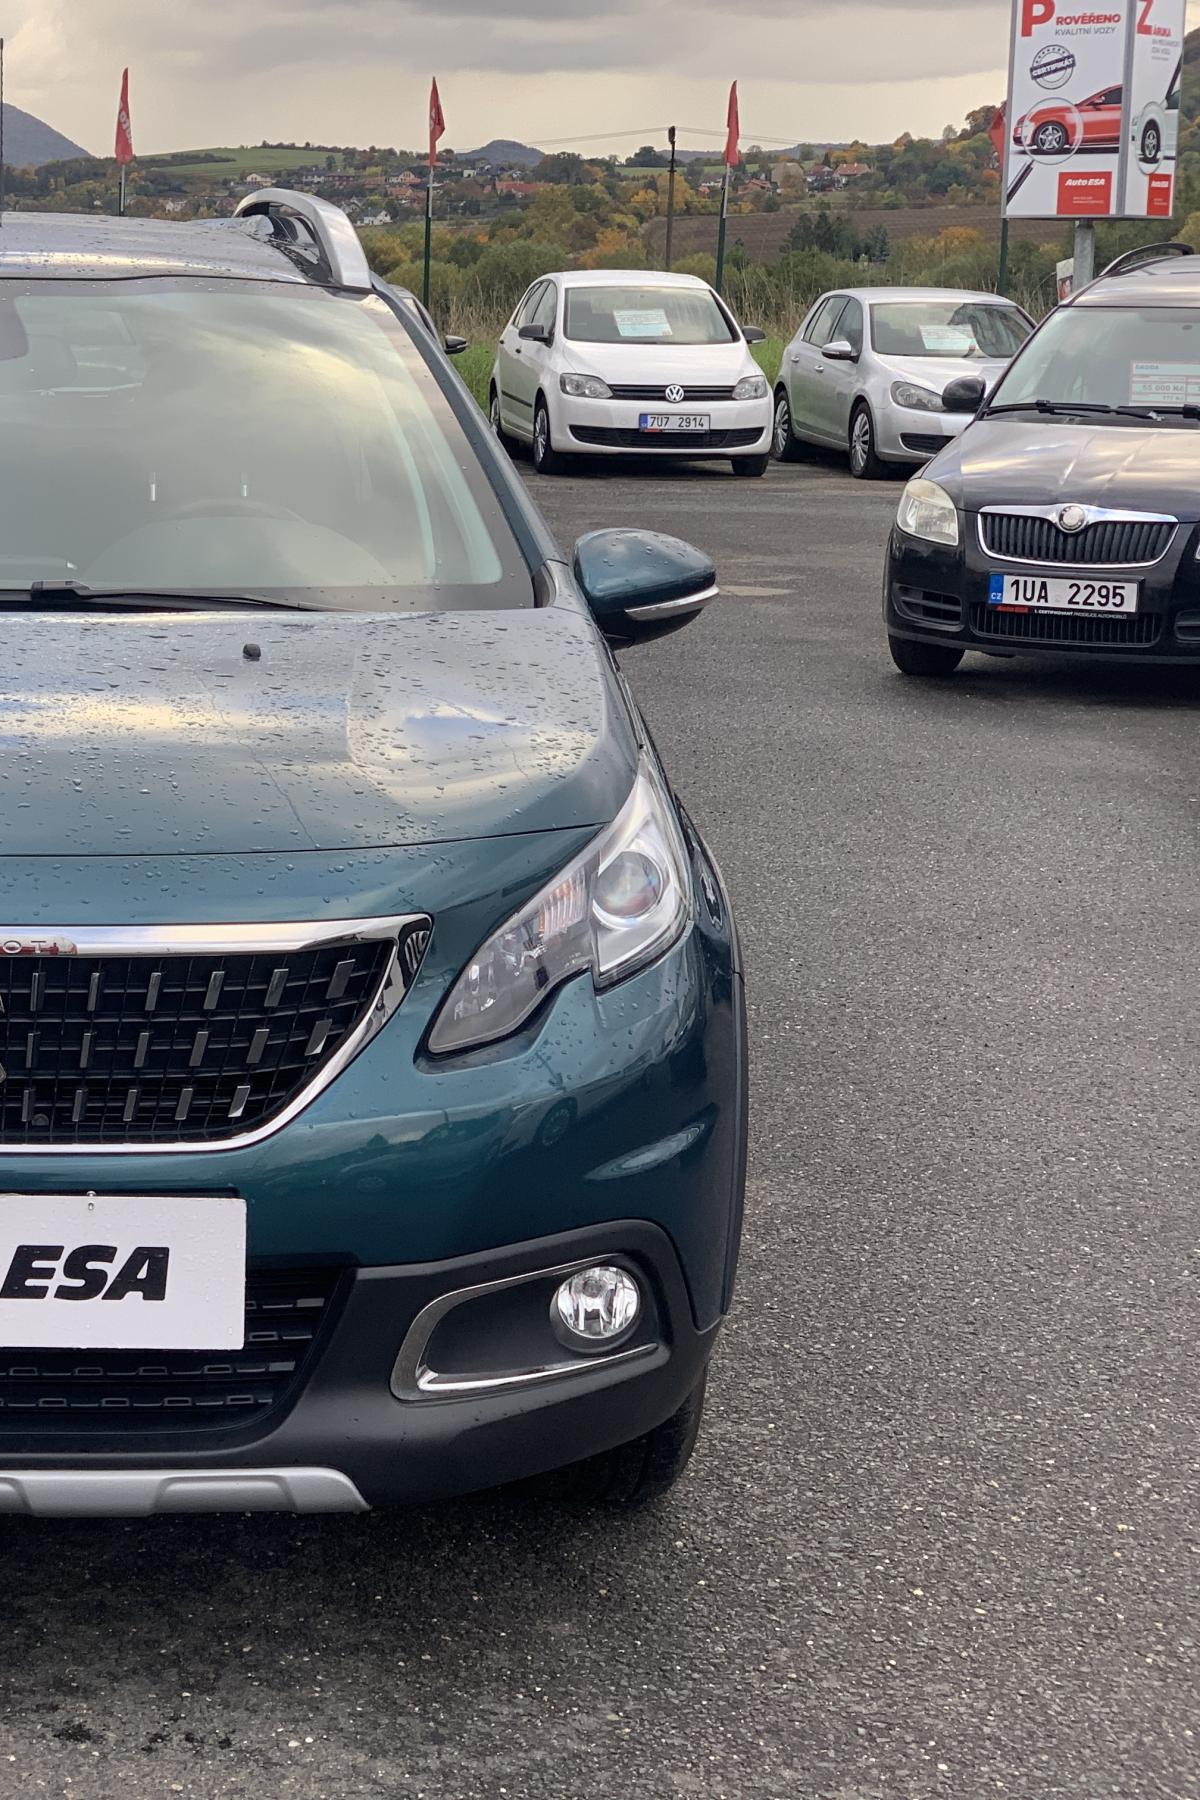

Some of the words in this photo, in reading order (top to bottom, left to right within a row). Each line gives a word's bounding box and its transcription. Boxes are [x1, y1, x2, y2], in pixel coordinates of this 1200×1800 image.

[1055, 26, 1092, 36] KVALITNÍ
[1094, 26, 1117, 35] VOZY
[1065, 179, 1088, 187] Auto
[1088, 179, 1106, 187] ESA
[650, 416, 670, 427] 7U7
[678, 416, 704, 428] 2914
[990, 592, 1002, 600] CZ
[1010, 579, 1049, 604] 1UA
[1067, 583, 1126, 608] 2295
